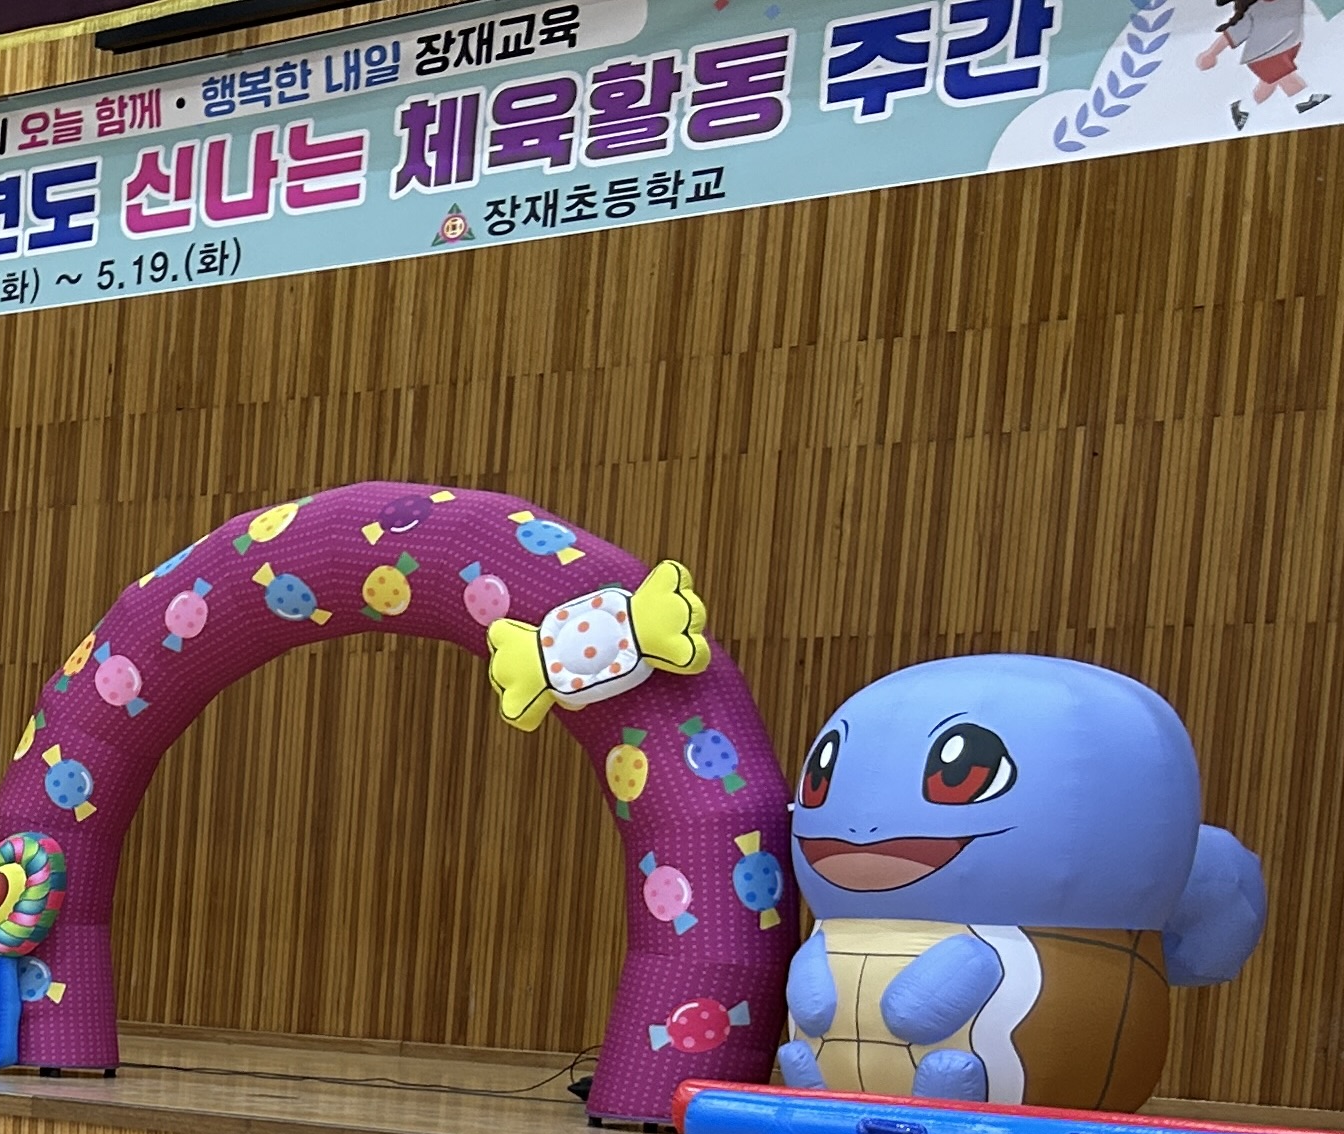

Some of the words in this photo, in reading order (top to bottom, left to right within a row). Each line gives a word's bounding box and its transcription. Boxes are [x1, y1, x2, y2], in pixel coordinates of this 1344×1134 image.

[18, 107, 86, 151] 오늘
[95, 88, 163, 140] 함께
[201, 57, 313, 119] 행복한
[323, 39, 403, 95] 내일
[414, 3, 582, 74] 장재교육
[124, 124, 366, 234] 신나는
[396, 36, 789, 192] 체육활동
[825, 0, 1055, 116] 주간
[483, 167, 728, 237] 장재초등학교
[96, 236, 243, 292] 5.19.(화)
